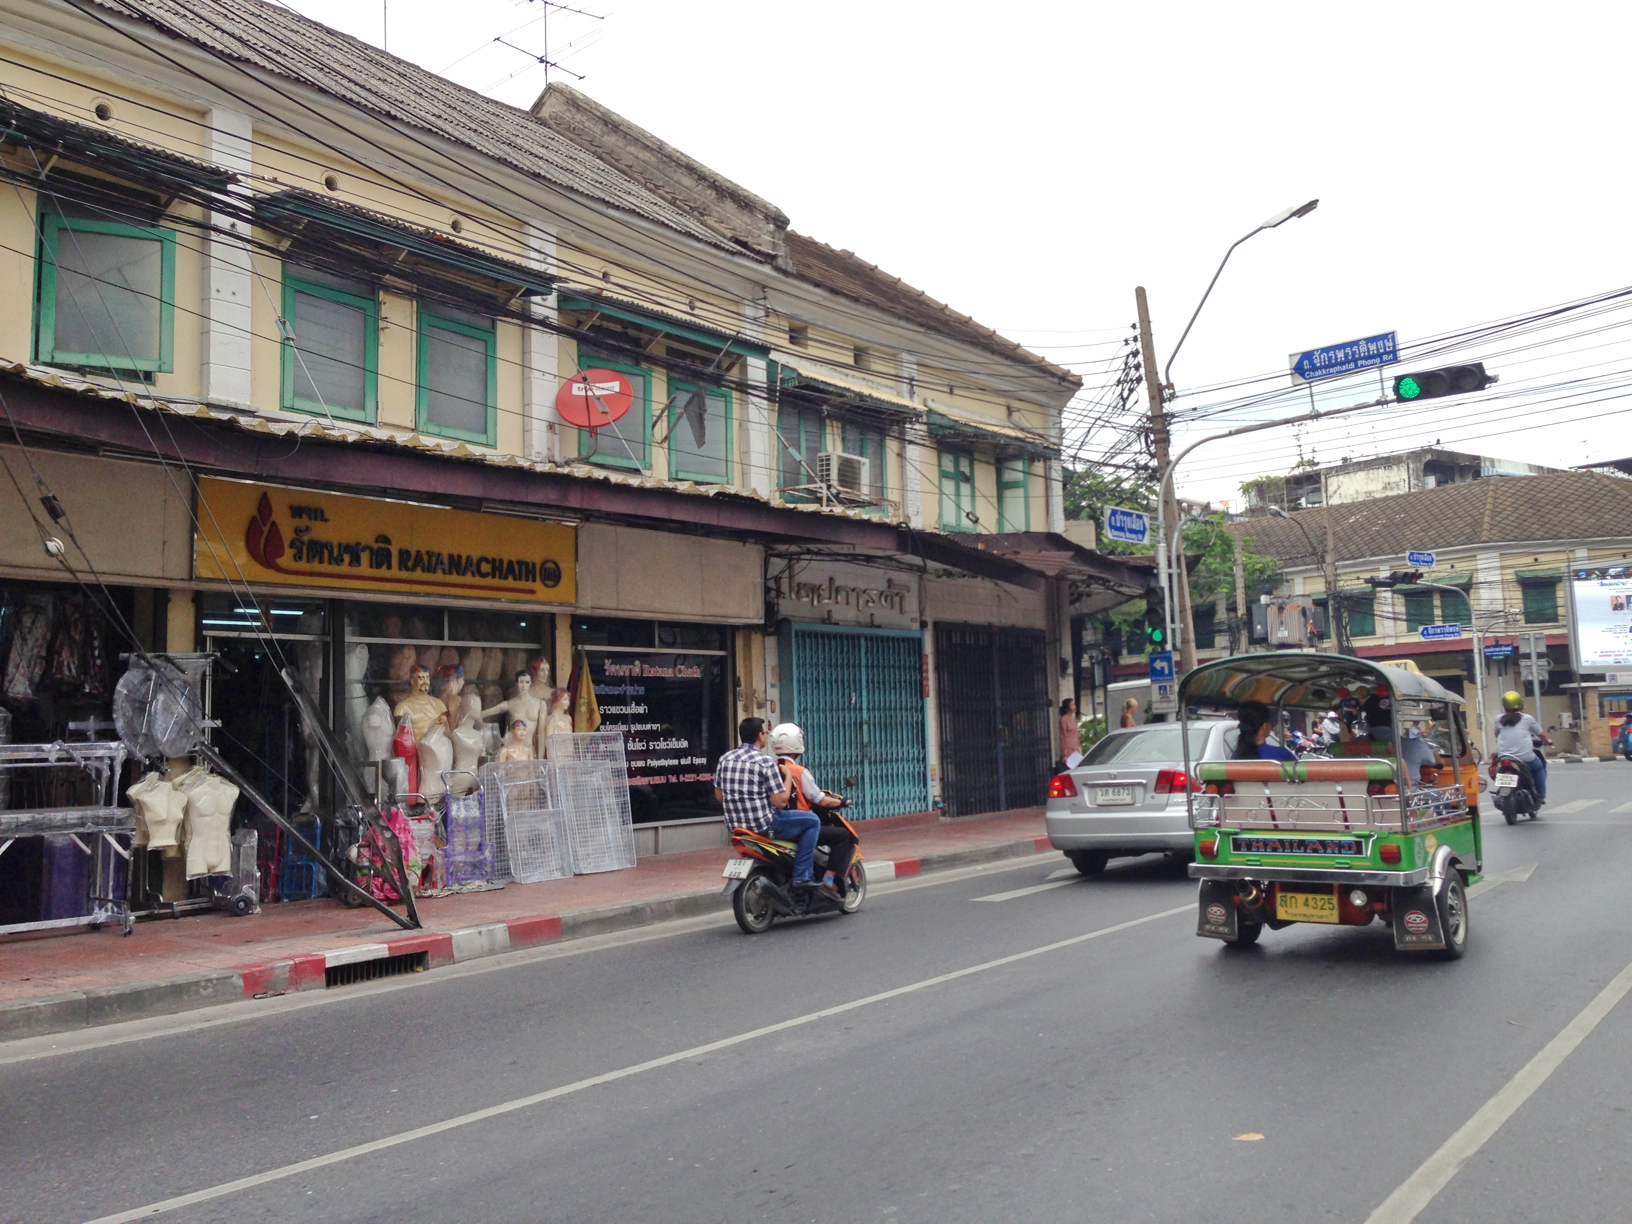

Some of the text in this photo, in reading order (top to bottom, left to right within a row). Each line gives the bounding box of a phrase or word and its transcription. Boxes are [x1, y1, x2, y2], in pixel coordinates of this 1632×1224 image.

[1305, 353, 1394, 379] Chakkraphatdi Phong Rd
[289, 504, 330, 522] หจก.
[289, 525, 392, 571] รัตนชาติ
[398, 547, 537, 583] RATANACHATH
[693, 756, 707, 766] Epoxy
[1112, 787, 1131, 797] 6873
[1237, 838, 1357, 855] THAILAND
[1303, 896, 1336, 911] 4325
